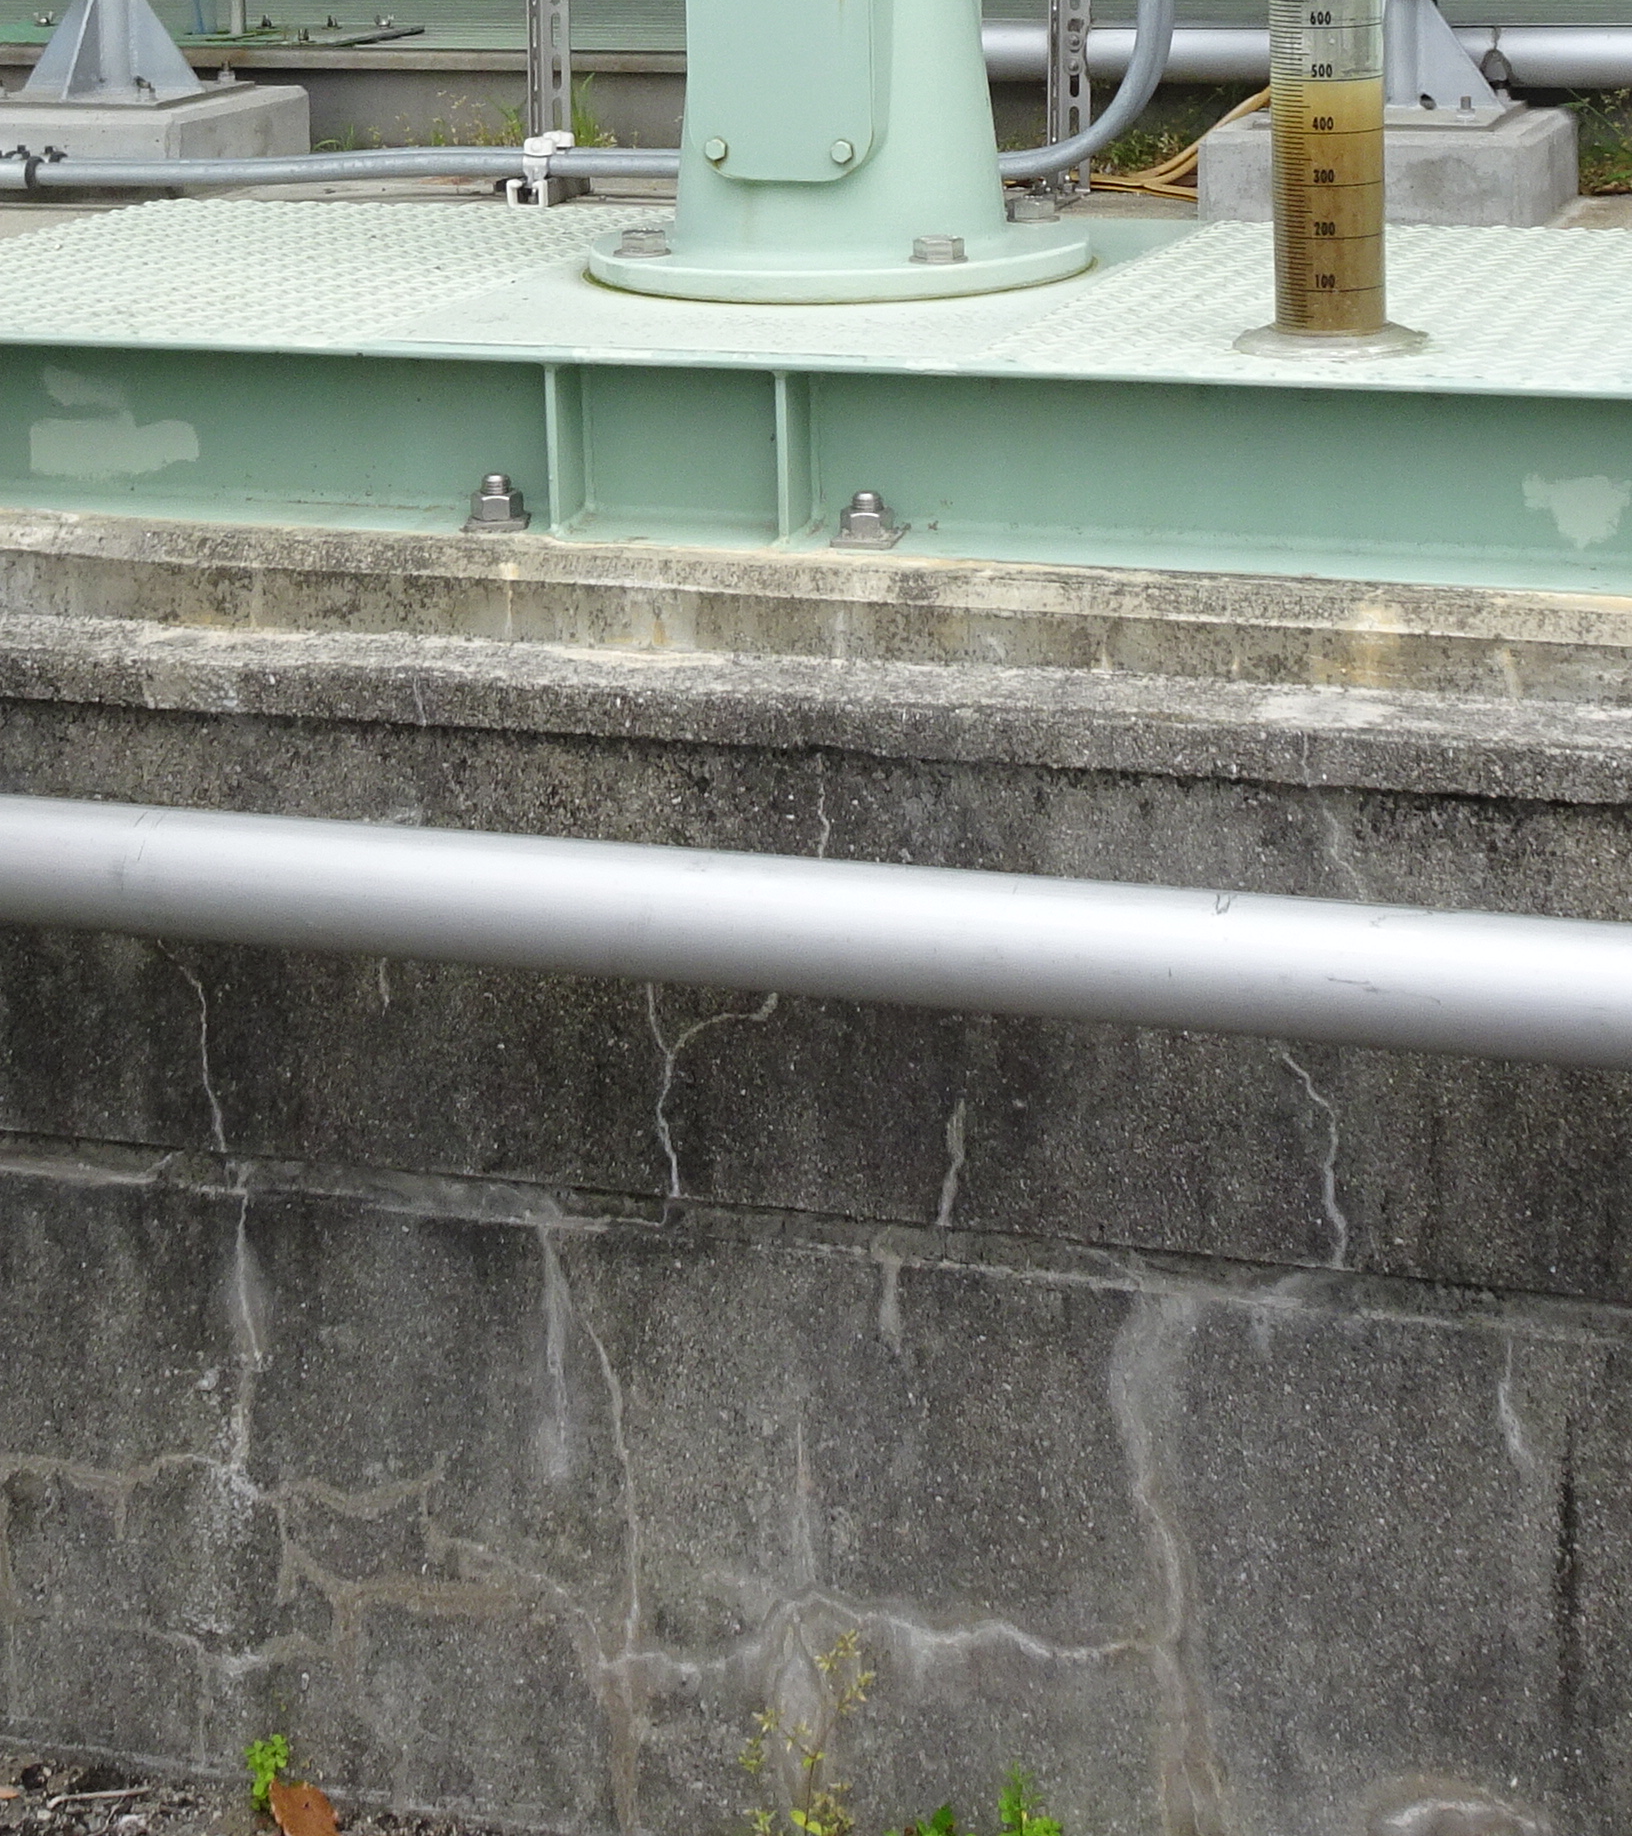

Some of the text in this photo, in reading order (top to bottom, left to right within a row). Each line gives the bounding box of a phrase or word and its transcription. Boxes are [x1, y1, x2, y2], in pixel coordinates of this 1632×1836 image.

[1310, 11, 1332, 25] 600
[1311, 64, 1333, 78] 500
[1312, 116, 1334, 130] 400
[1313, 169, 1335, 183] 300
[1314, 222, 1336, 236] 200
[1314, 274, 1336, 288] 100
